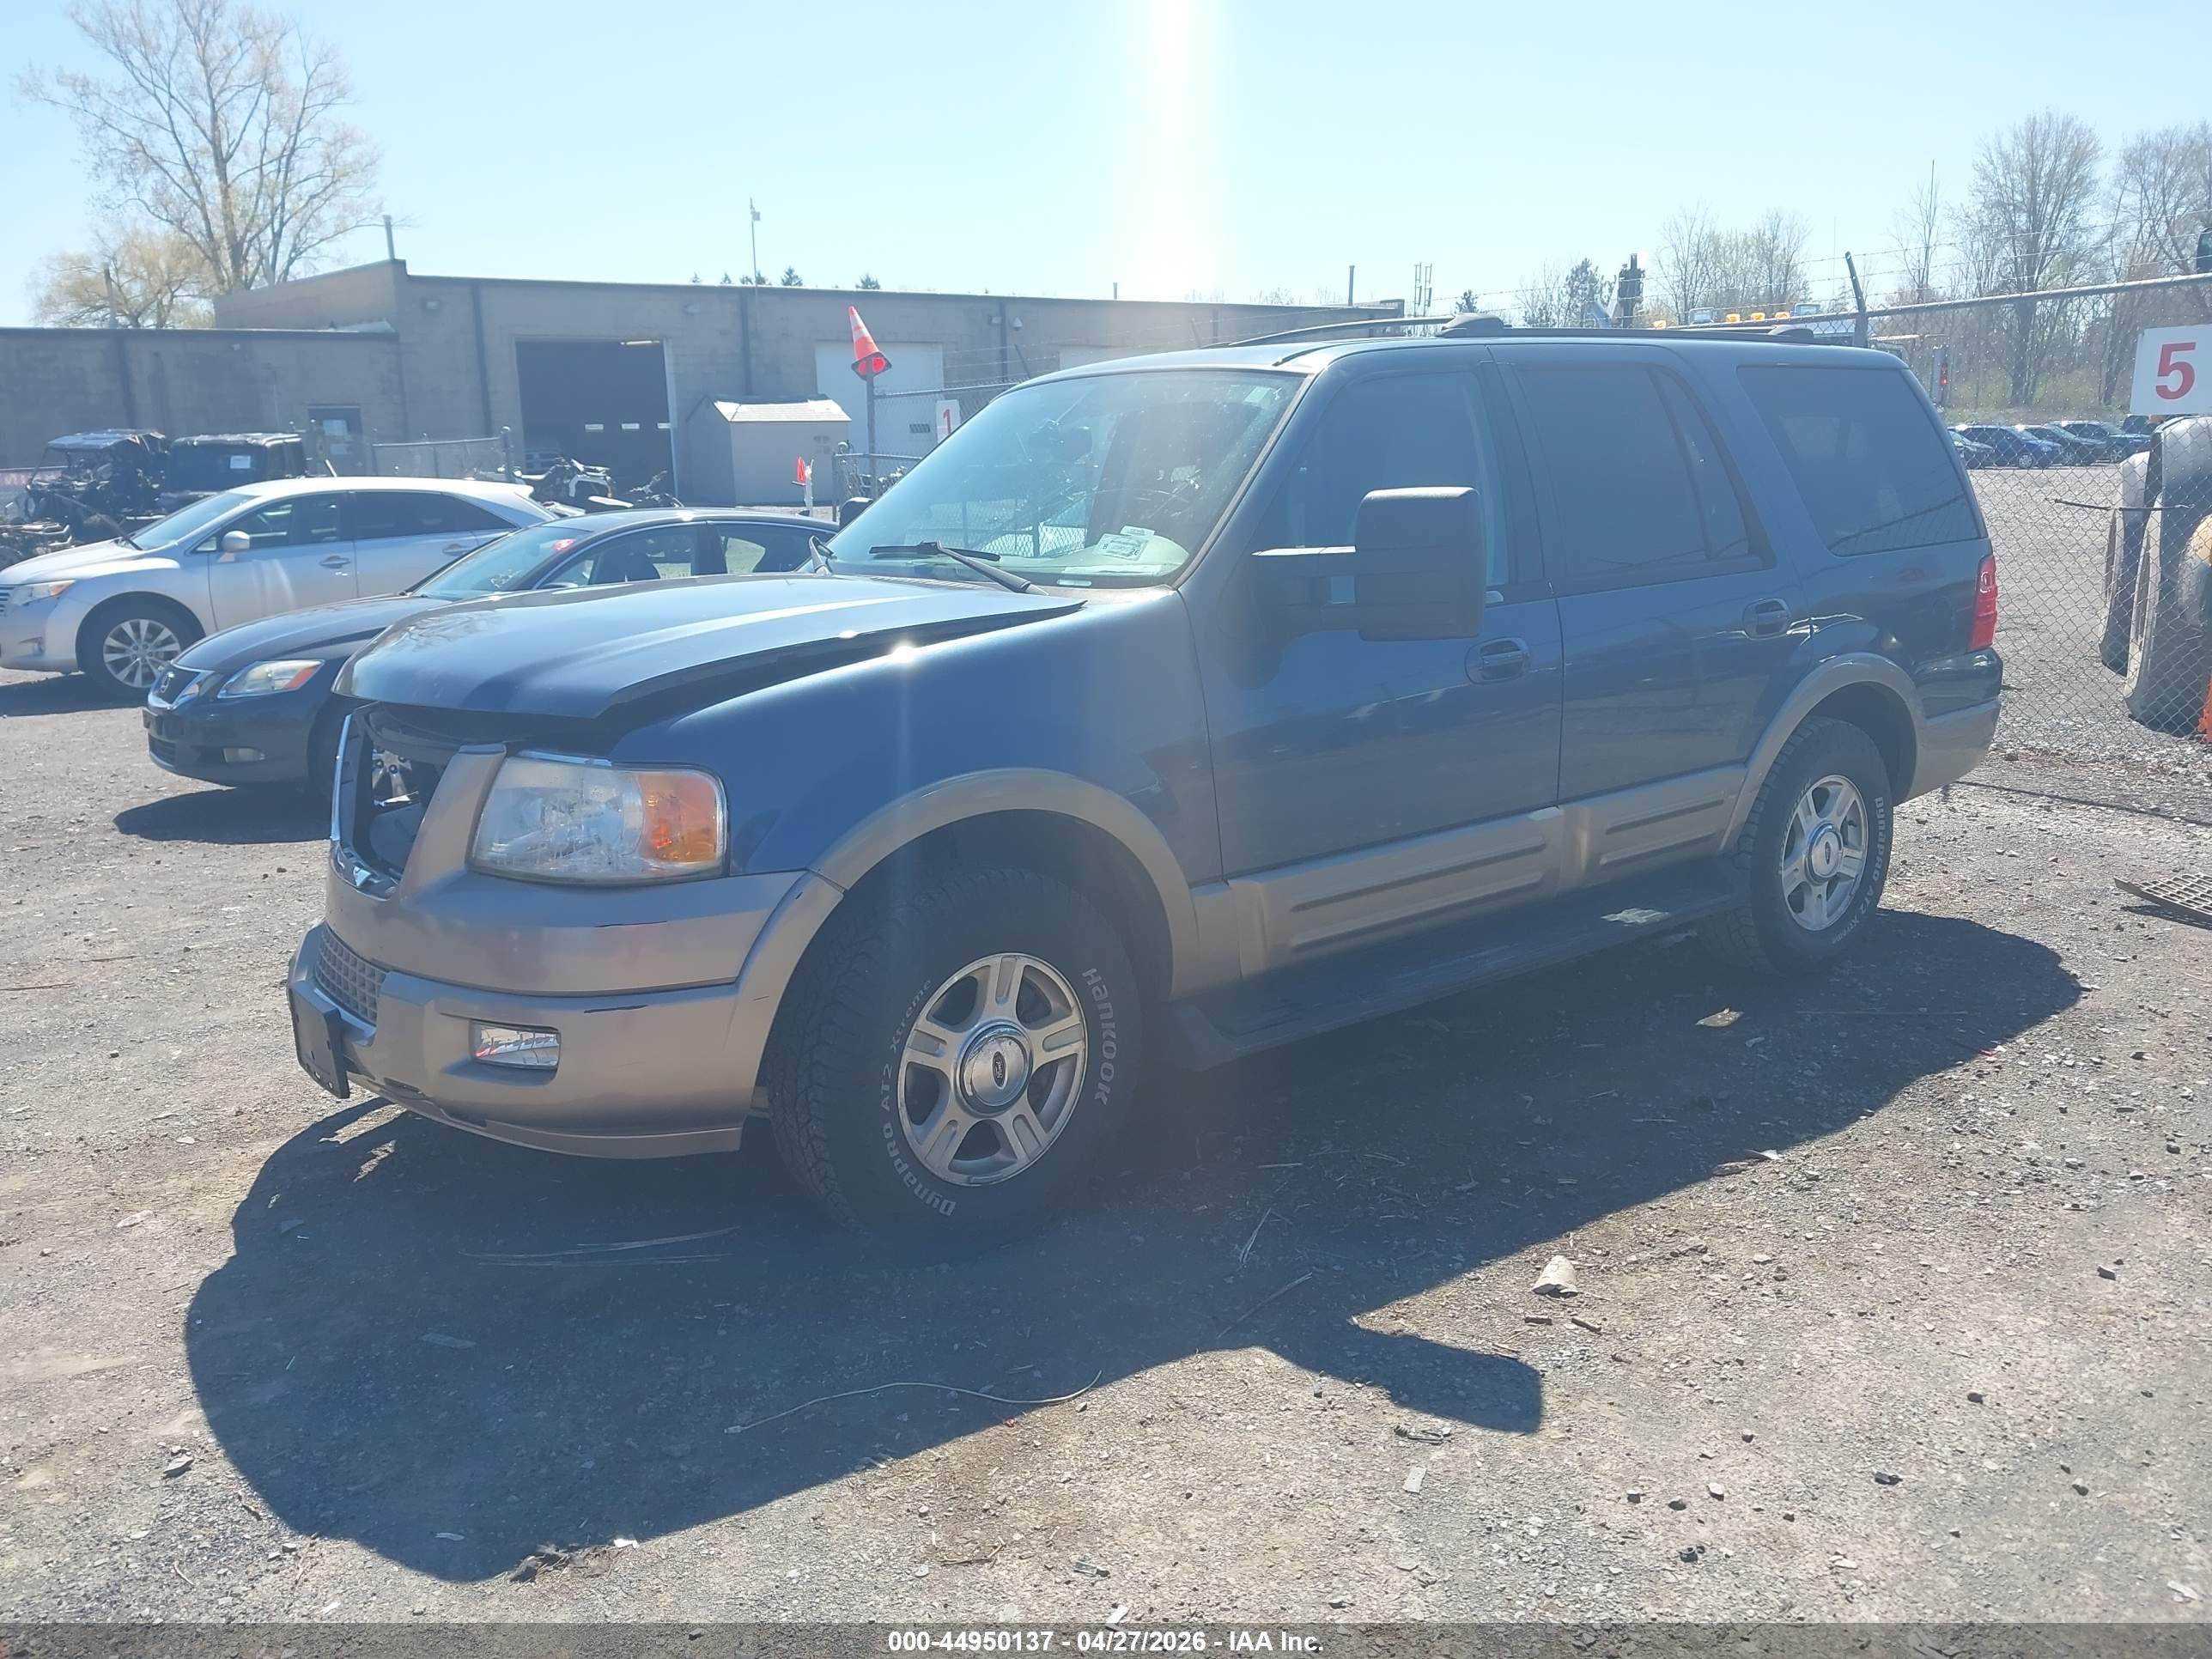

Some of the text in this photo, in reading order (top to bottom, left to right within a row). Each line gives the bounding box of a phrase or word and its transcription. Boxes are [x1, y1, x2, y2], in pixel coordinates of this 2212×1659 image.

[2155, 342, 2197, 400] 5
[943, 408, 952, 434] 1
[881, 1064, 893, 1111] AT2
[890, 980, 932, 1054] Xtreme
